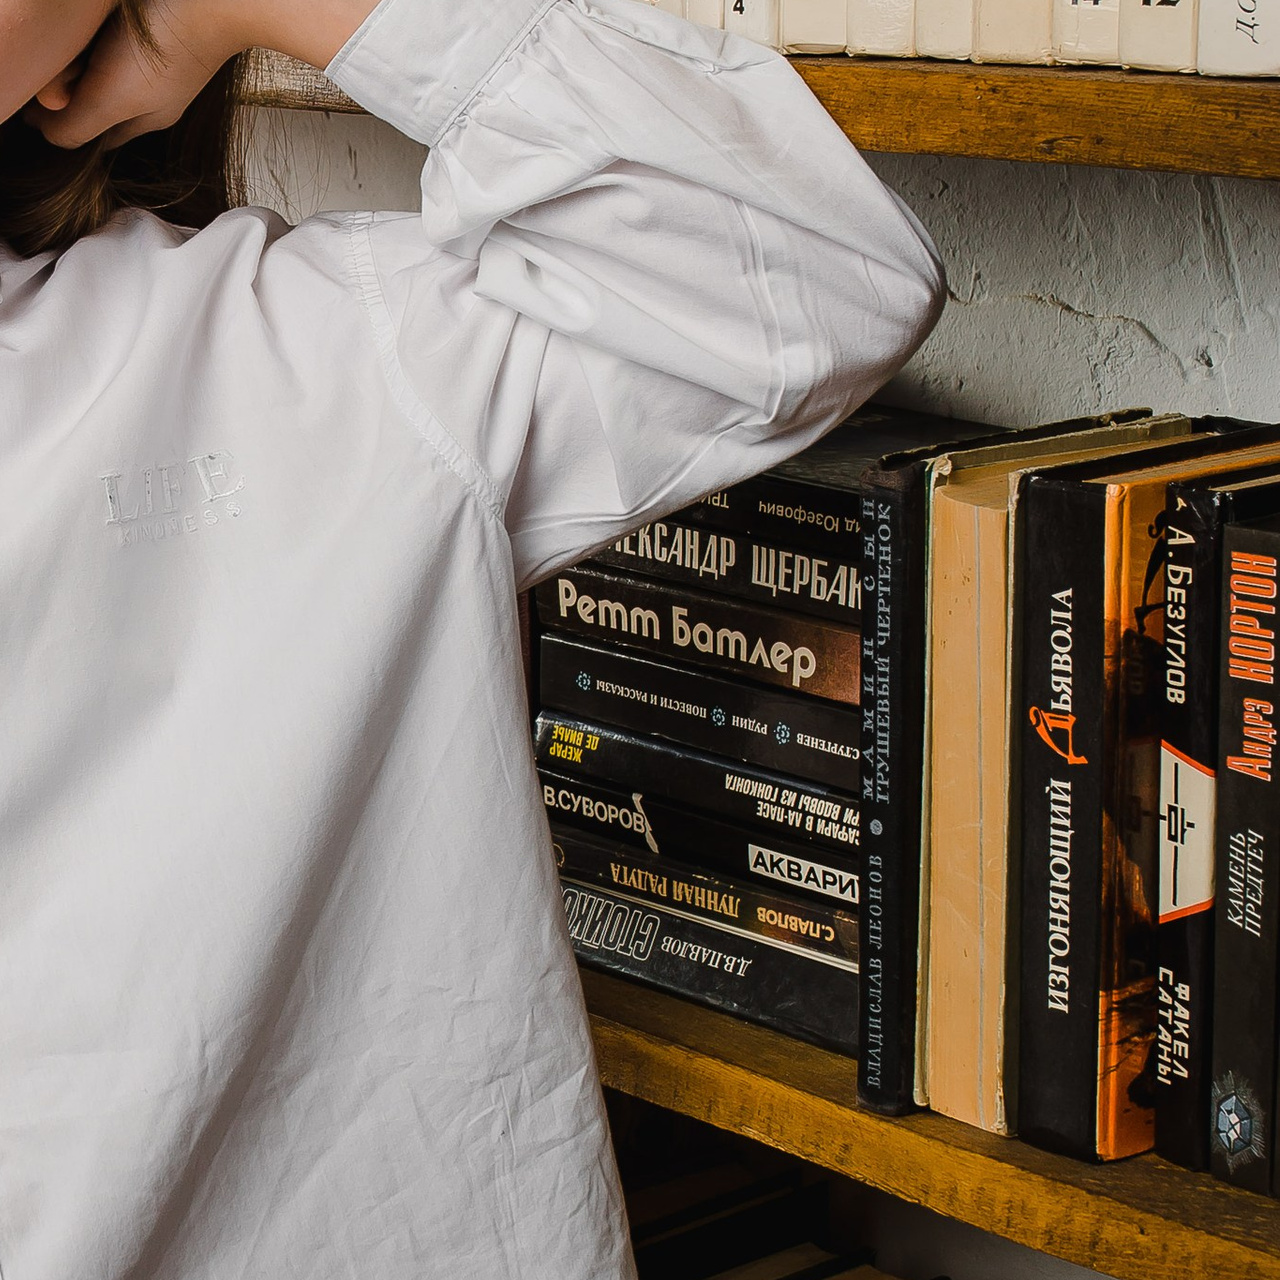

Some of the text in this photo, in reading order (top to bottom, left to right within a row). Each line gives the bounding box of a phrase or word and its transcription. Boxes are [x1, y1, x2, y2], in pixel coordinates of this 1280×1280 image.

[98, 450, 246, 525] LIFE
[758, 501, 840, 533] Юзефович
[558, 579, 816, 687] Ретт Батлер
[862, 499, 876, 801] МАМИН СЫН
[875, 501, 893, 805] ГРУШЕВЫЙ ЧЕРТЕНОК
[1167, 525, 1196, 705] А.БЕЗУГЛОВ
[1229, 551, 1277, 685] НОРТОН
[596, 679, 648, 703] РАССКАЗЫ
[660, 697, 707, 718] ПОВЕСТИ
[731, 716, 768, 735] РУДИН
[549, 742, 582, 764] ЖЕРАР
[552, 725, 600, 751] ДЕ ВИЛЬЕ
[543, 784, 647, 834] В.СУВОРОВ
[724, 773, 840, 820] ВДОВЫ ИЗ ГОНКОНГА
[756, 800, 813, 832] В ЛА-ПАСЕ
[1029, 587, 1088, 1014] ИЗГОНЯЮЩИЙ ДЬЯВОЛА
[609, 862, 835, 942] С.ПАВЛОВ ЛУННАЯ РАДУГА
[1227, 832, 1246, 928] КАМЕНЬ
[1245, 829, 1264, 938] ПРЕДТЕЧ
[661, 935, 753, 977] Д.В.ПАВЛОВ
[867, 855, 883, 1089] ВЛАДИСЛАВ ЛЕОНОВ
[1157, 967, 1173, 1086] САТАНЫ
[1175, 983, 1190, 1079] ФАКЕЛ
